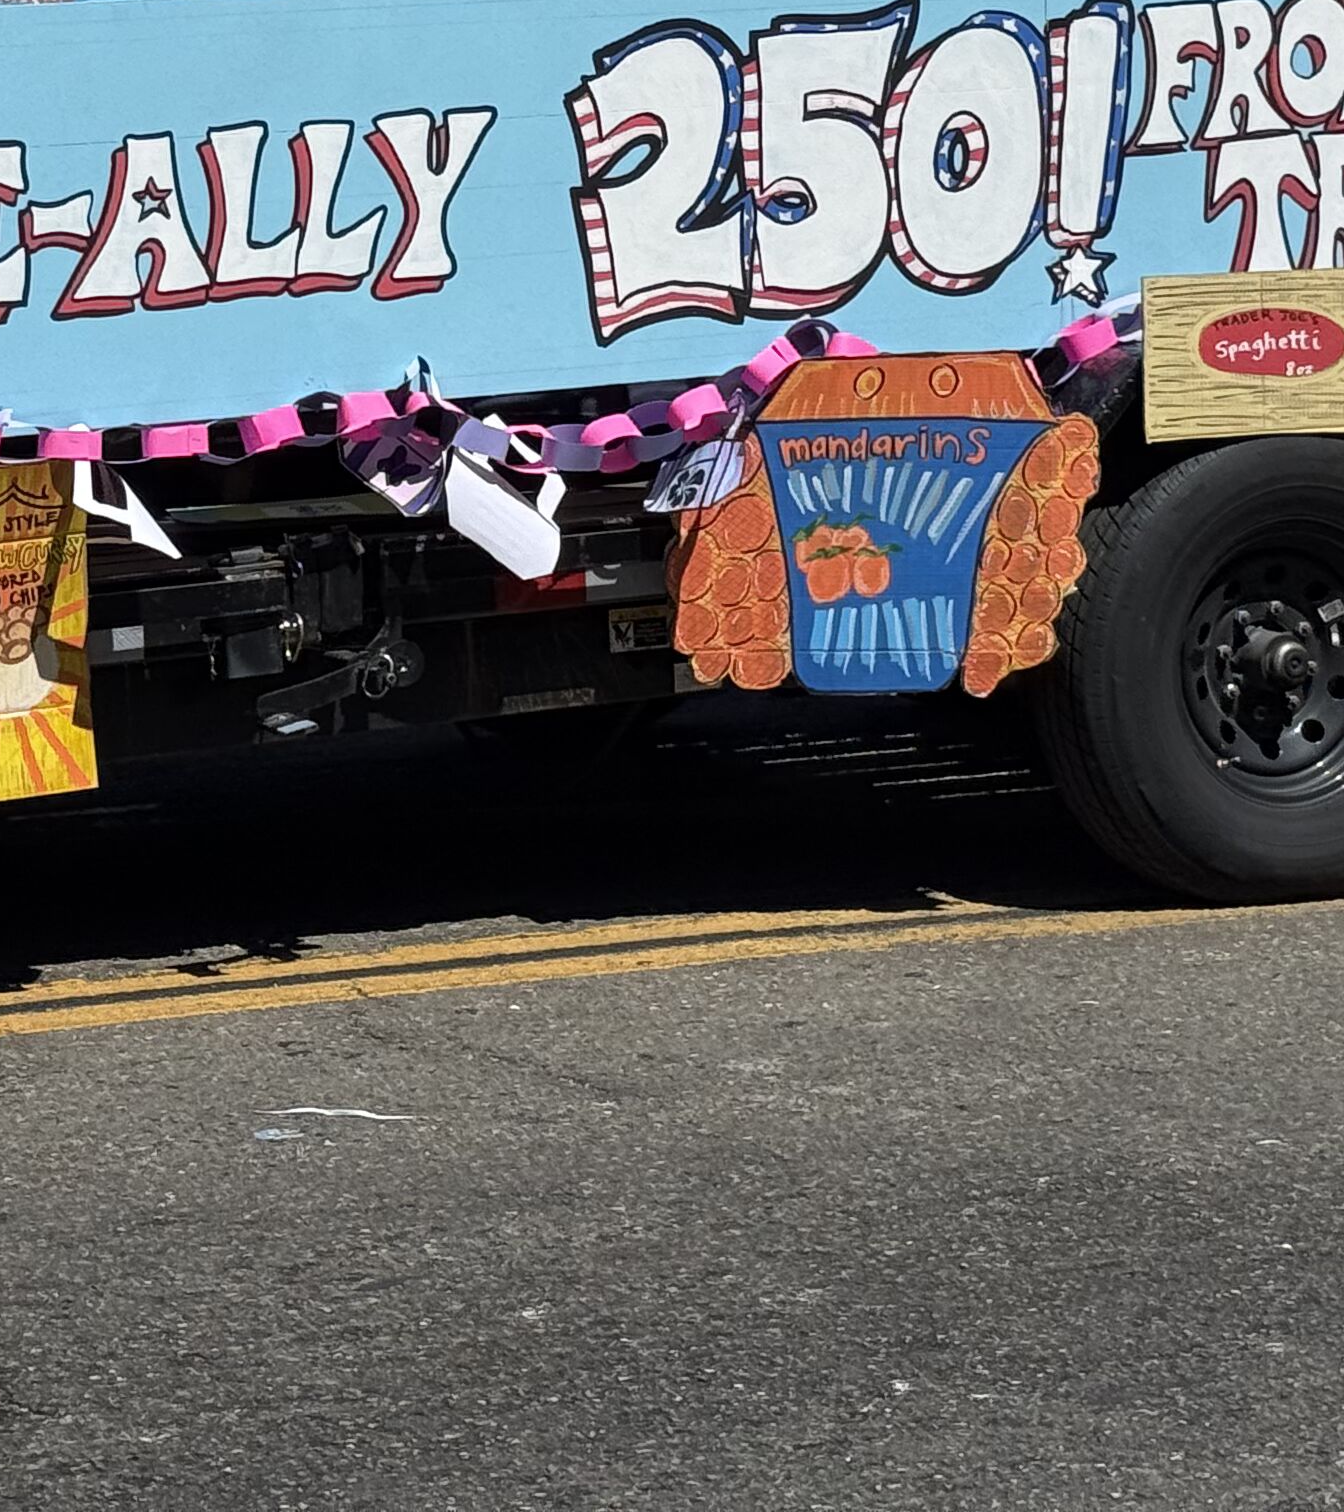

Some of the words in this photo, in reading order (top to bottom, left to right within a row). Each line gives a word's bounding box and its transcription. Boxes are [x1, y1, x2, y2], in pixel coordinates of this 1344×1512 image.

[1213, 308, 1273, 332] TRADER
[1279, 308, 1319, 327] JOE'S
[1214, 329, 1323, 362] Spaghetti
[777, 424, 992, 470] mandarins
[4, 511, 60, 532] STYLE
